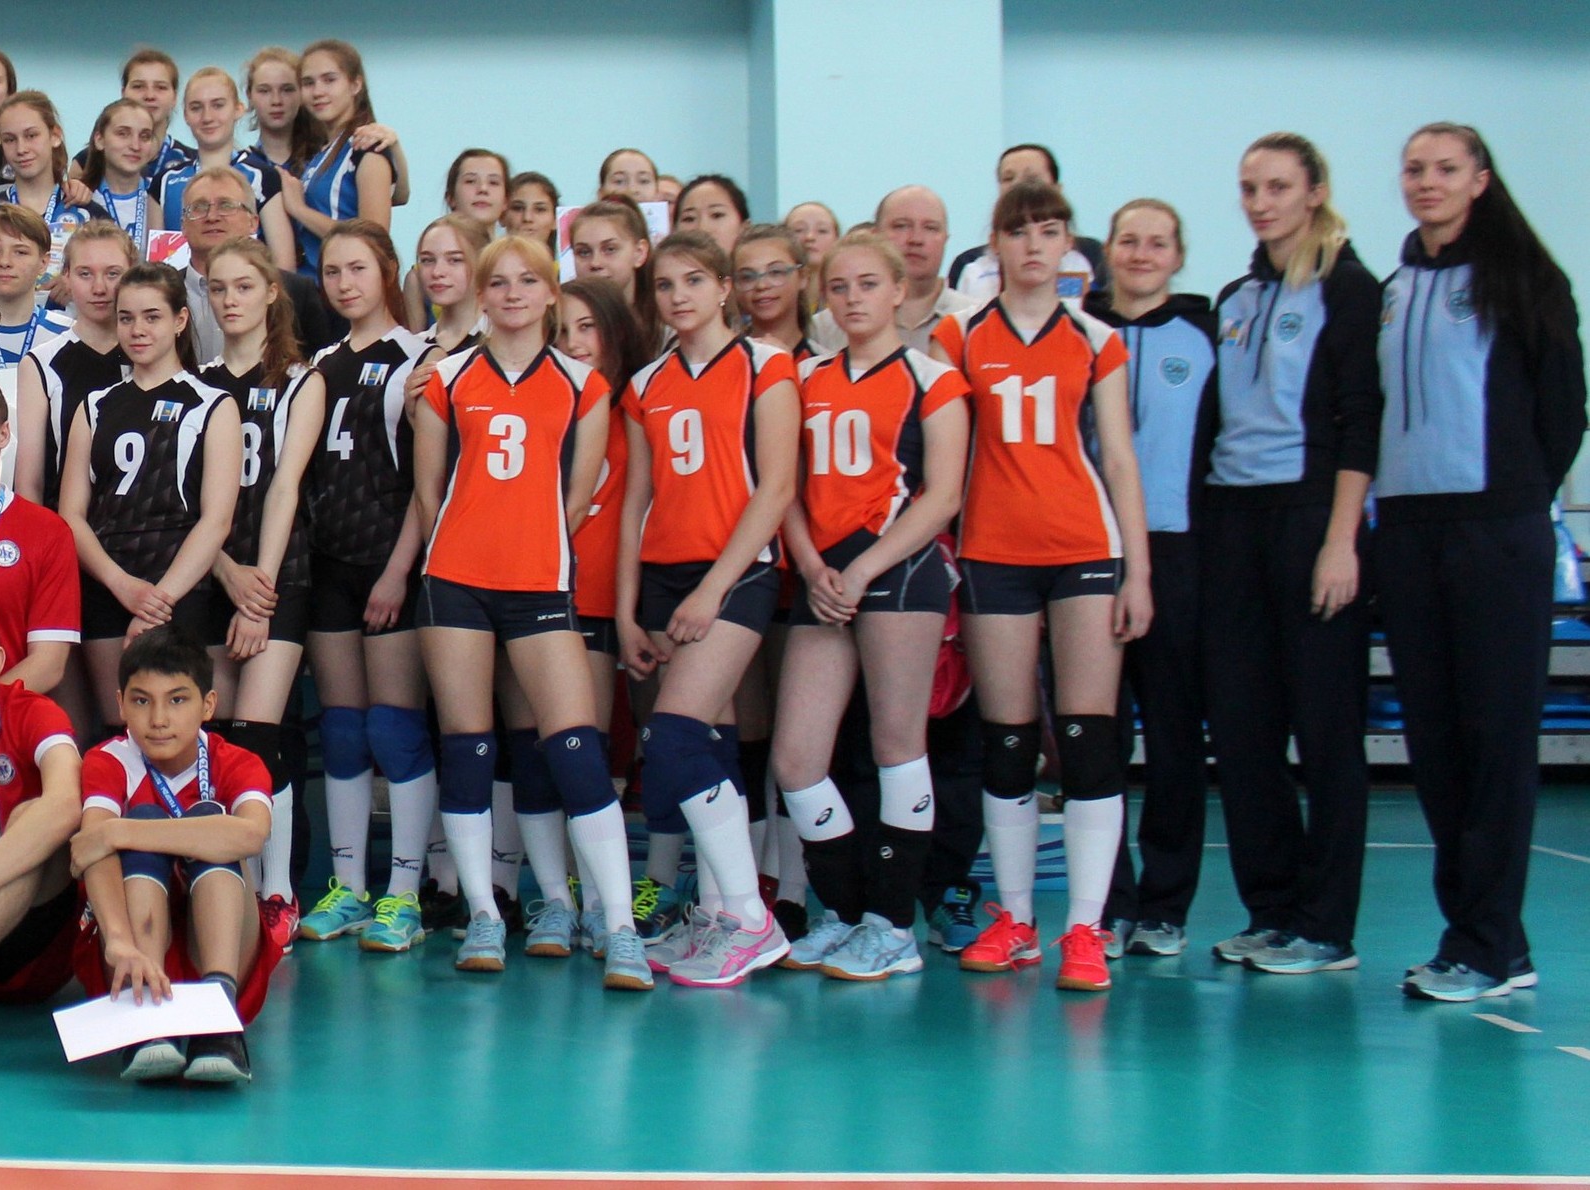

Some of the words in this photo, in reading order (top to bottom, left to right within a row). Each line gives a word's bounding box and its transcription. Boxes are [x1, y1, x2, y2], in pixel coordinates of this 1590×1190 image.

[327, 397, 354, 460] 4
[668, 408, 705, 476] 9
[805, 409, 873, 476] 10
[990, 375, 1056, 445] 11
[114, 432, 145, 495] 9
[240, 422, 261, 487] 8
[487, 414, 527, 481] 3
